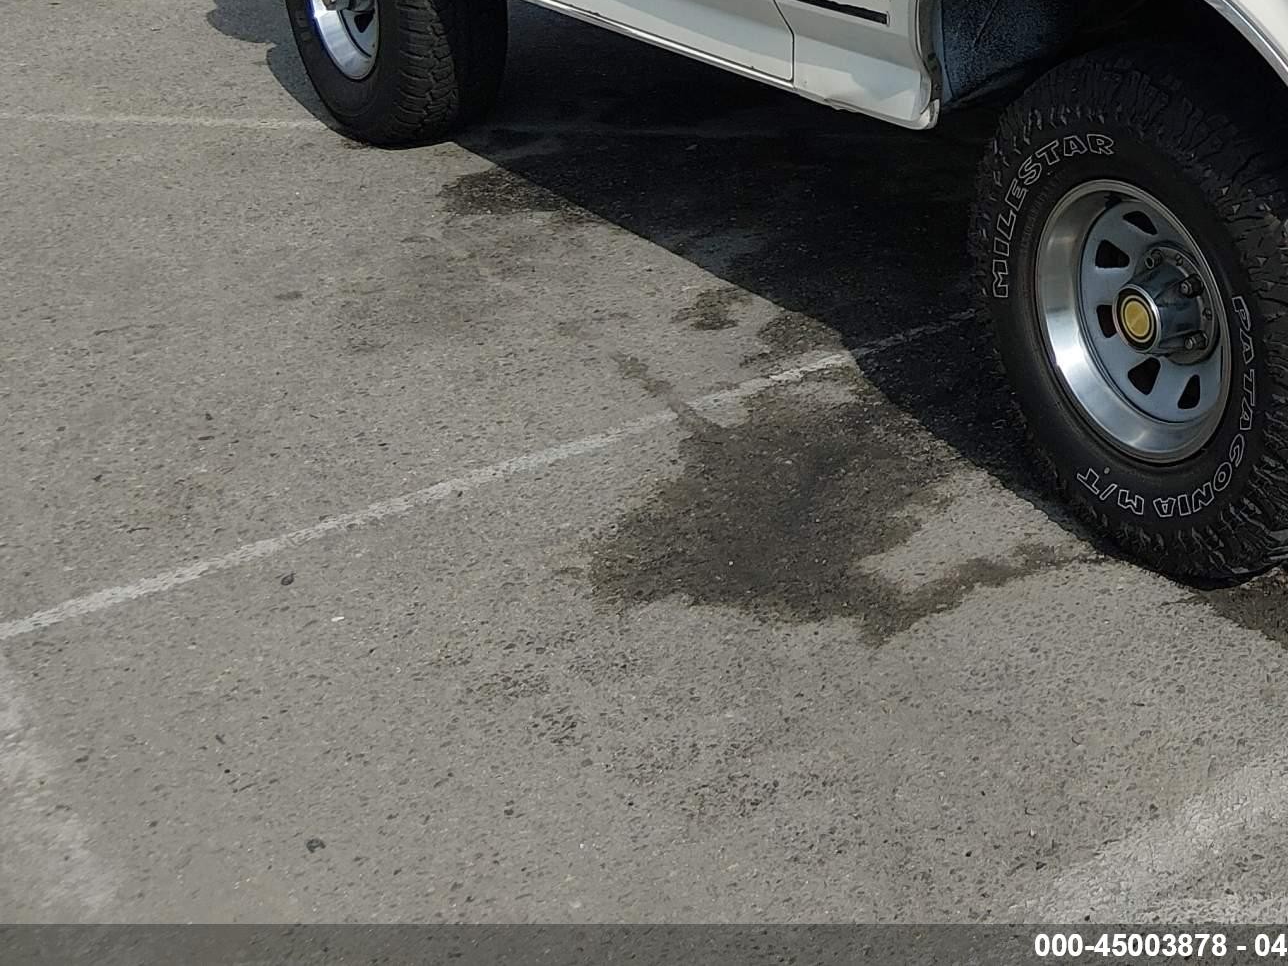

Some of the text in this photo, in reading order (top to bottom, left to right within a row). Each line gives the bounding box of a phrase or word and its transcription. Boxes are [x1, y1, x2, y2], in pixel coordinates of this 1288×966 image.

[992, 132, 1115, 299] MILESTAR
[1076, 295, 1257, 518] PATAGONIA M/T
